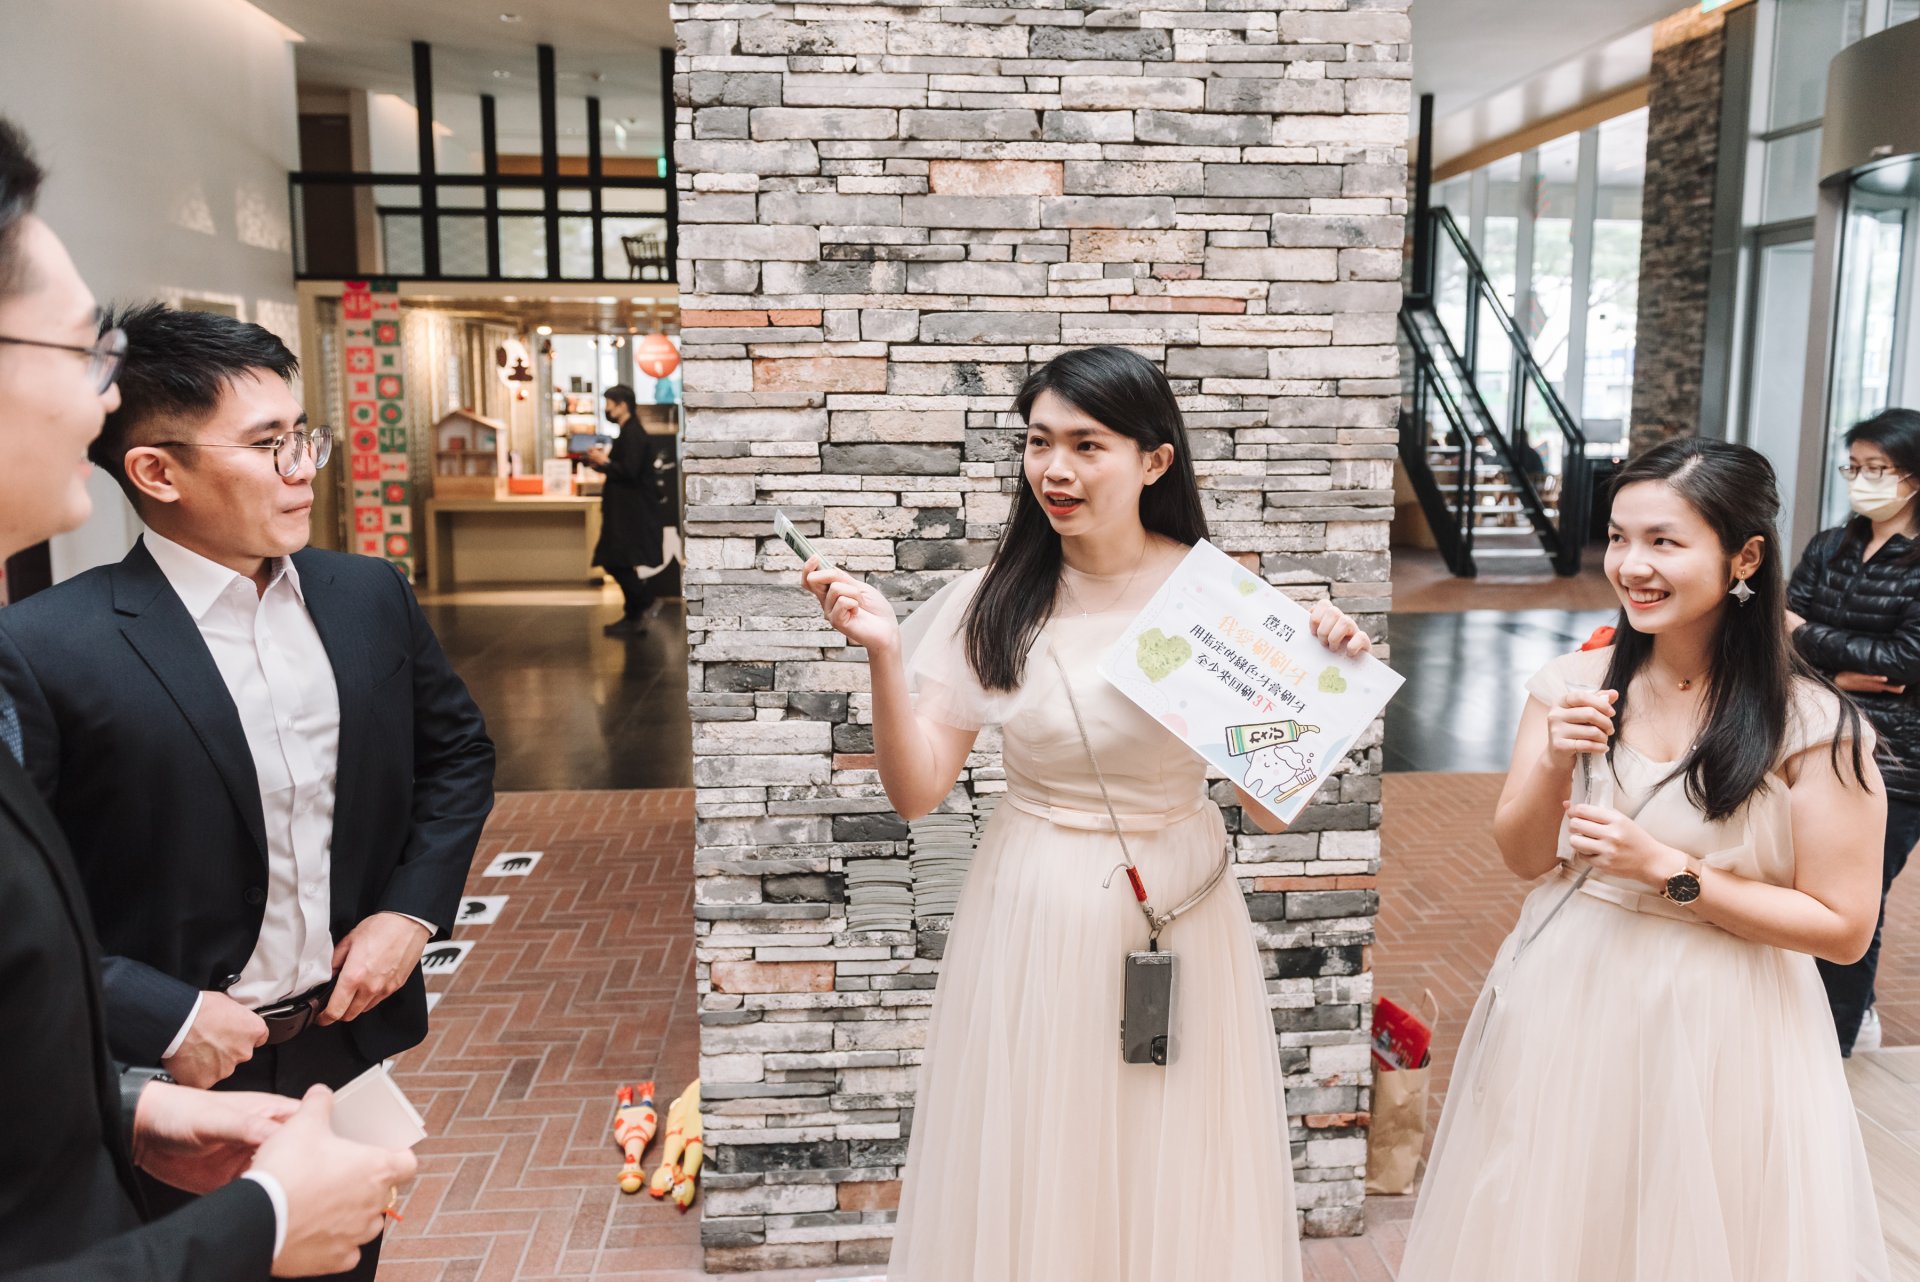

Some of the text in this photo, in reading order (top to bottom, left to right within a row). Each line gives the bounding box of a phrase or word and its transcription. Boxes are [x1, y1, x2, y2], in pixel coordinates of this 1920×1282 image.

[1218, 614, 1308, 686] 我愛刷刷牙
[1262, 614, 1296, 642] 懲罰
[1189, 624, 1306, 714] 用指定的綠色牙膏刷牙
[1195, 652, 1277, 713] 至少來回刷3下
[1249, 726, 1285, 744] わさび
